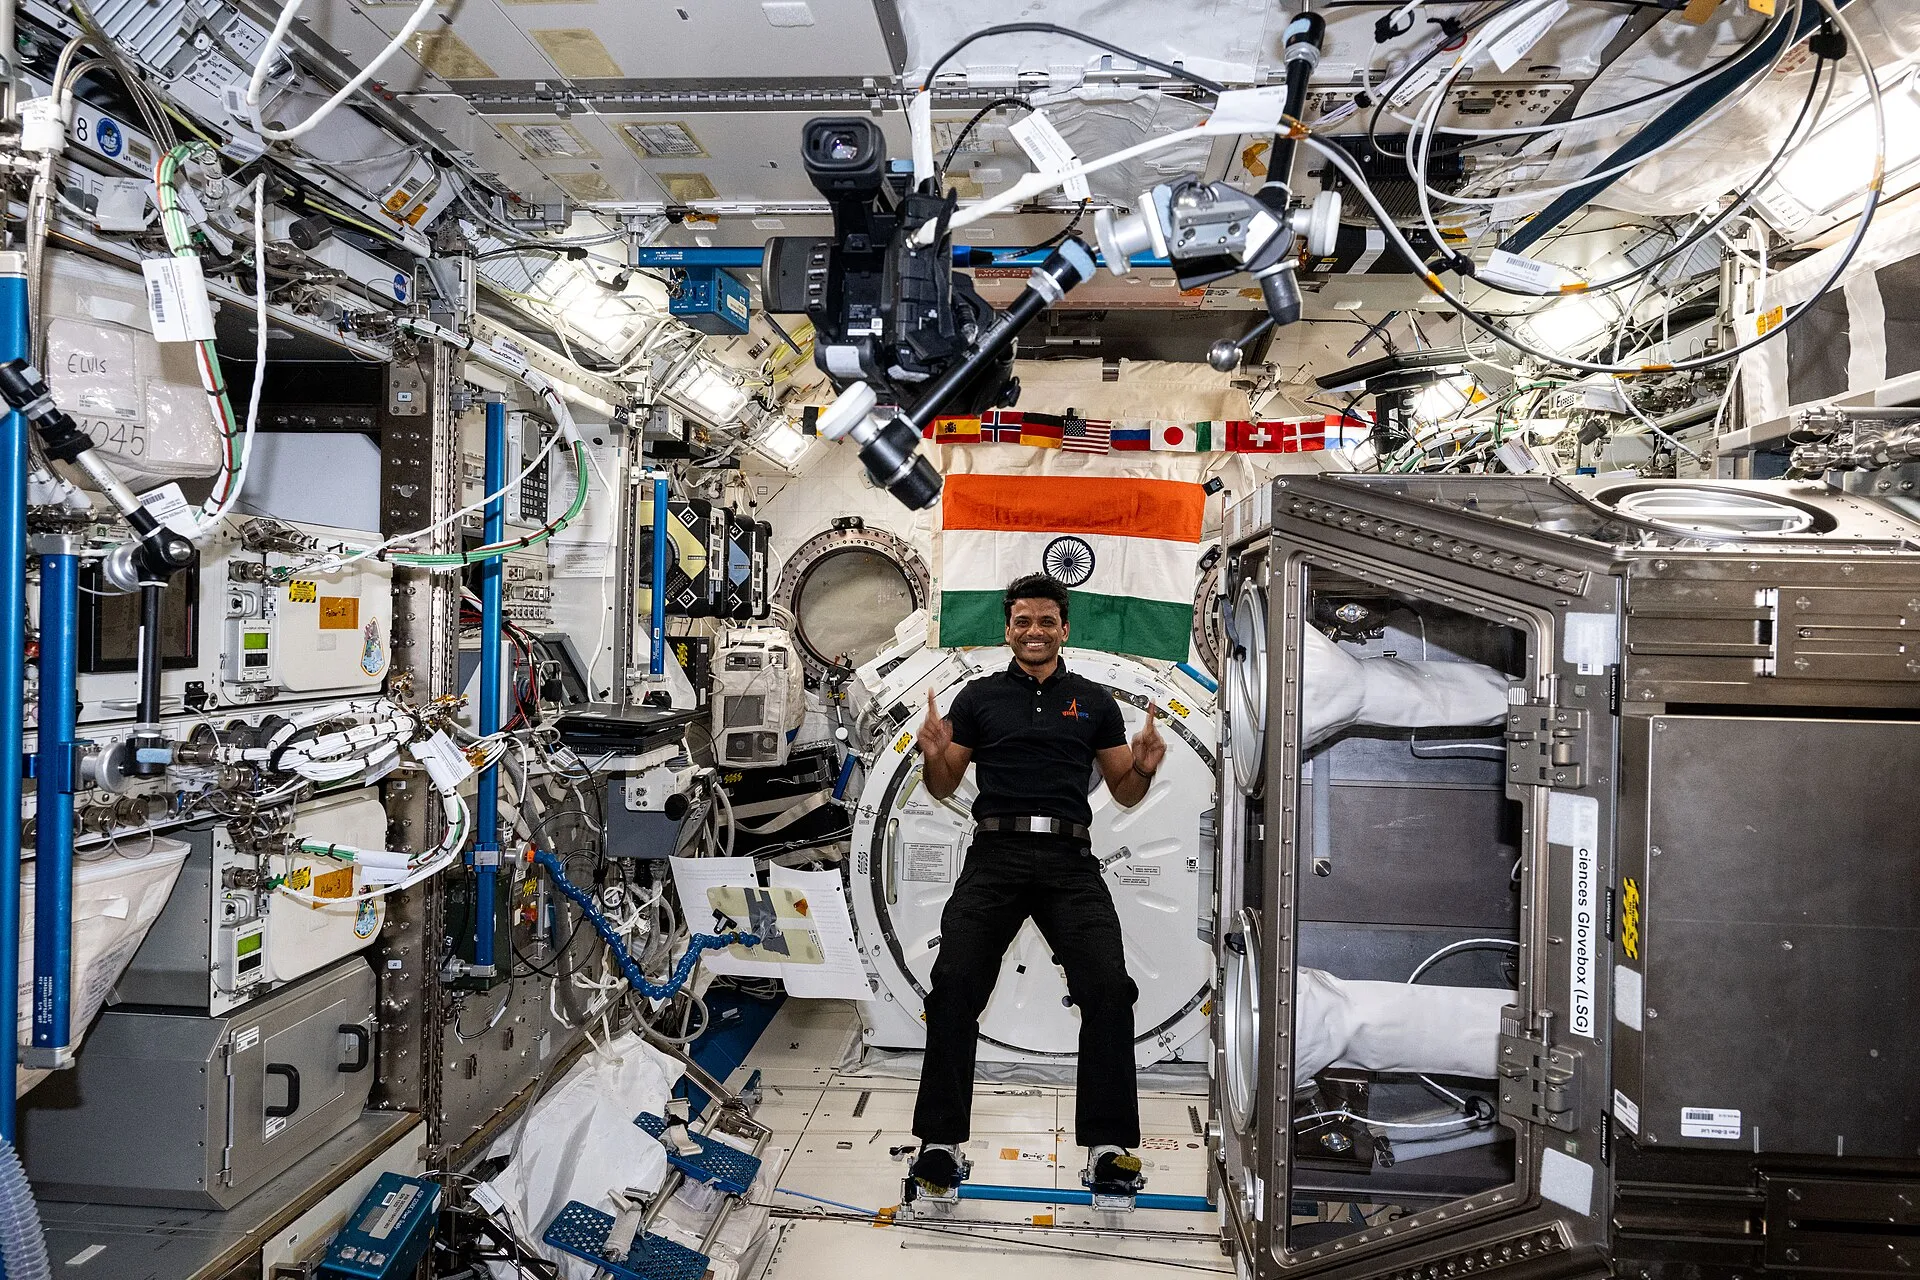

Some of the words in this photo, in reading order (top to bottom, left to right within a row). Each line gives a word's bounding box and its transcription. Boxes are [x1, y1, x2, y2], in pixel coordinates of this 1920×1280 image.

[77, 117, 88, 141] 8
[1577, 912, 1590, 985] Glovebox
[1573, 989, 1589, 1033] (LSG)
